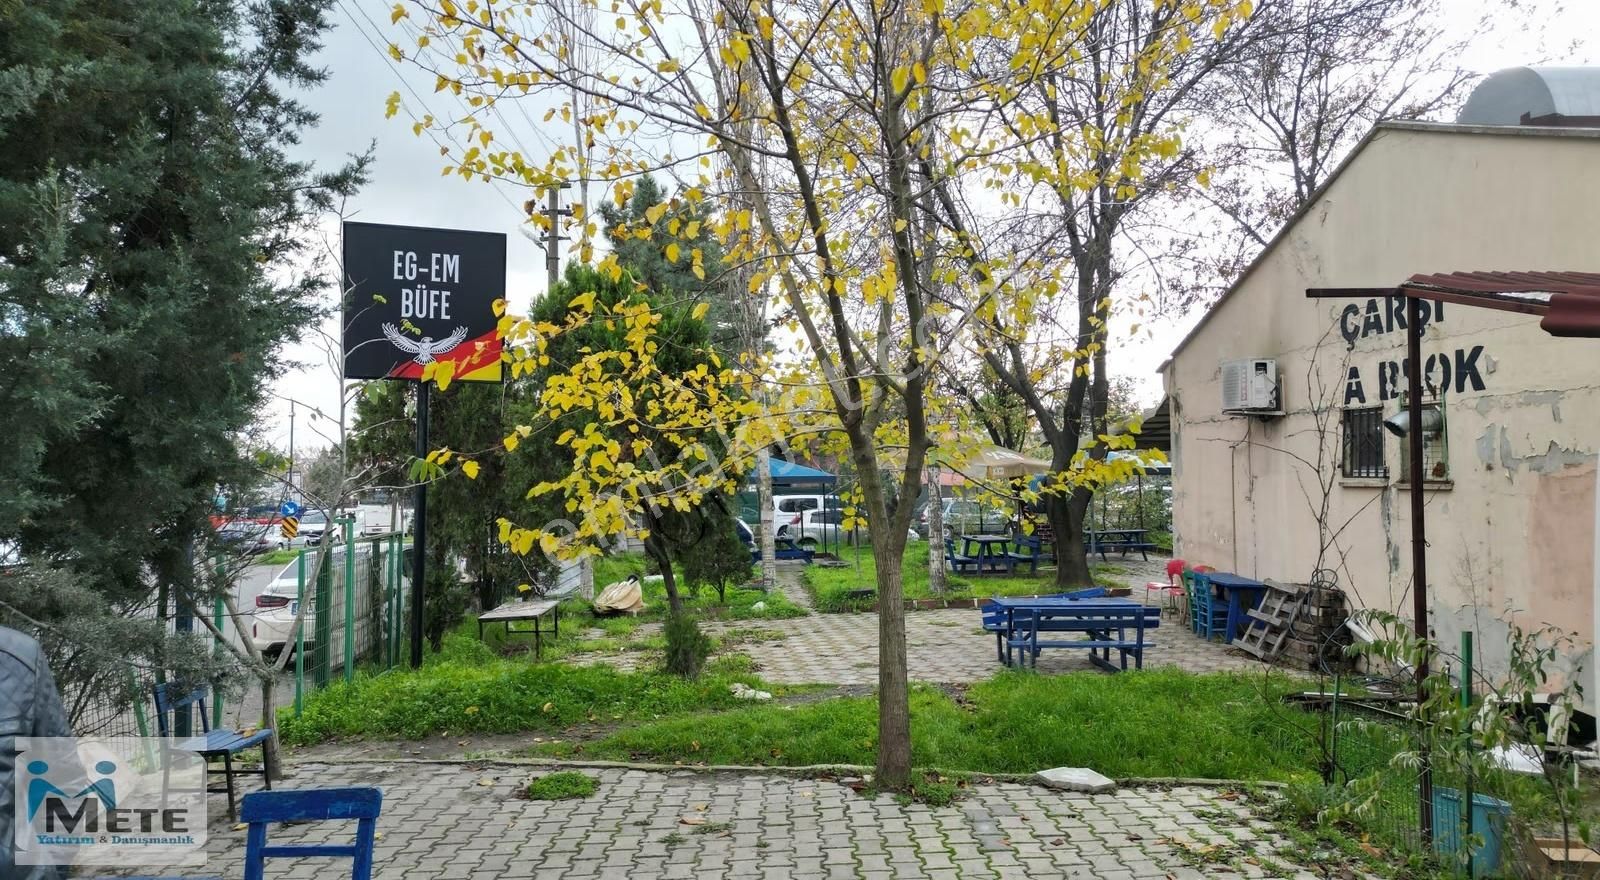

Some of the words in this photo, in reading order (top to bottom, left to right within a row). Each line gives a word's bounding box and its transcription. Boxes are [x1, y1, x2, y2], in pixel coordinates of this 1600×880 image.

[393, 250, 460, 283] EG-EM
[400, 285, 451, 320] BÜFE
[1344, 367, 1366, 404] A
[1379, 345, 1486, 401] BOK
